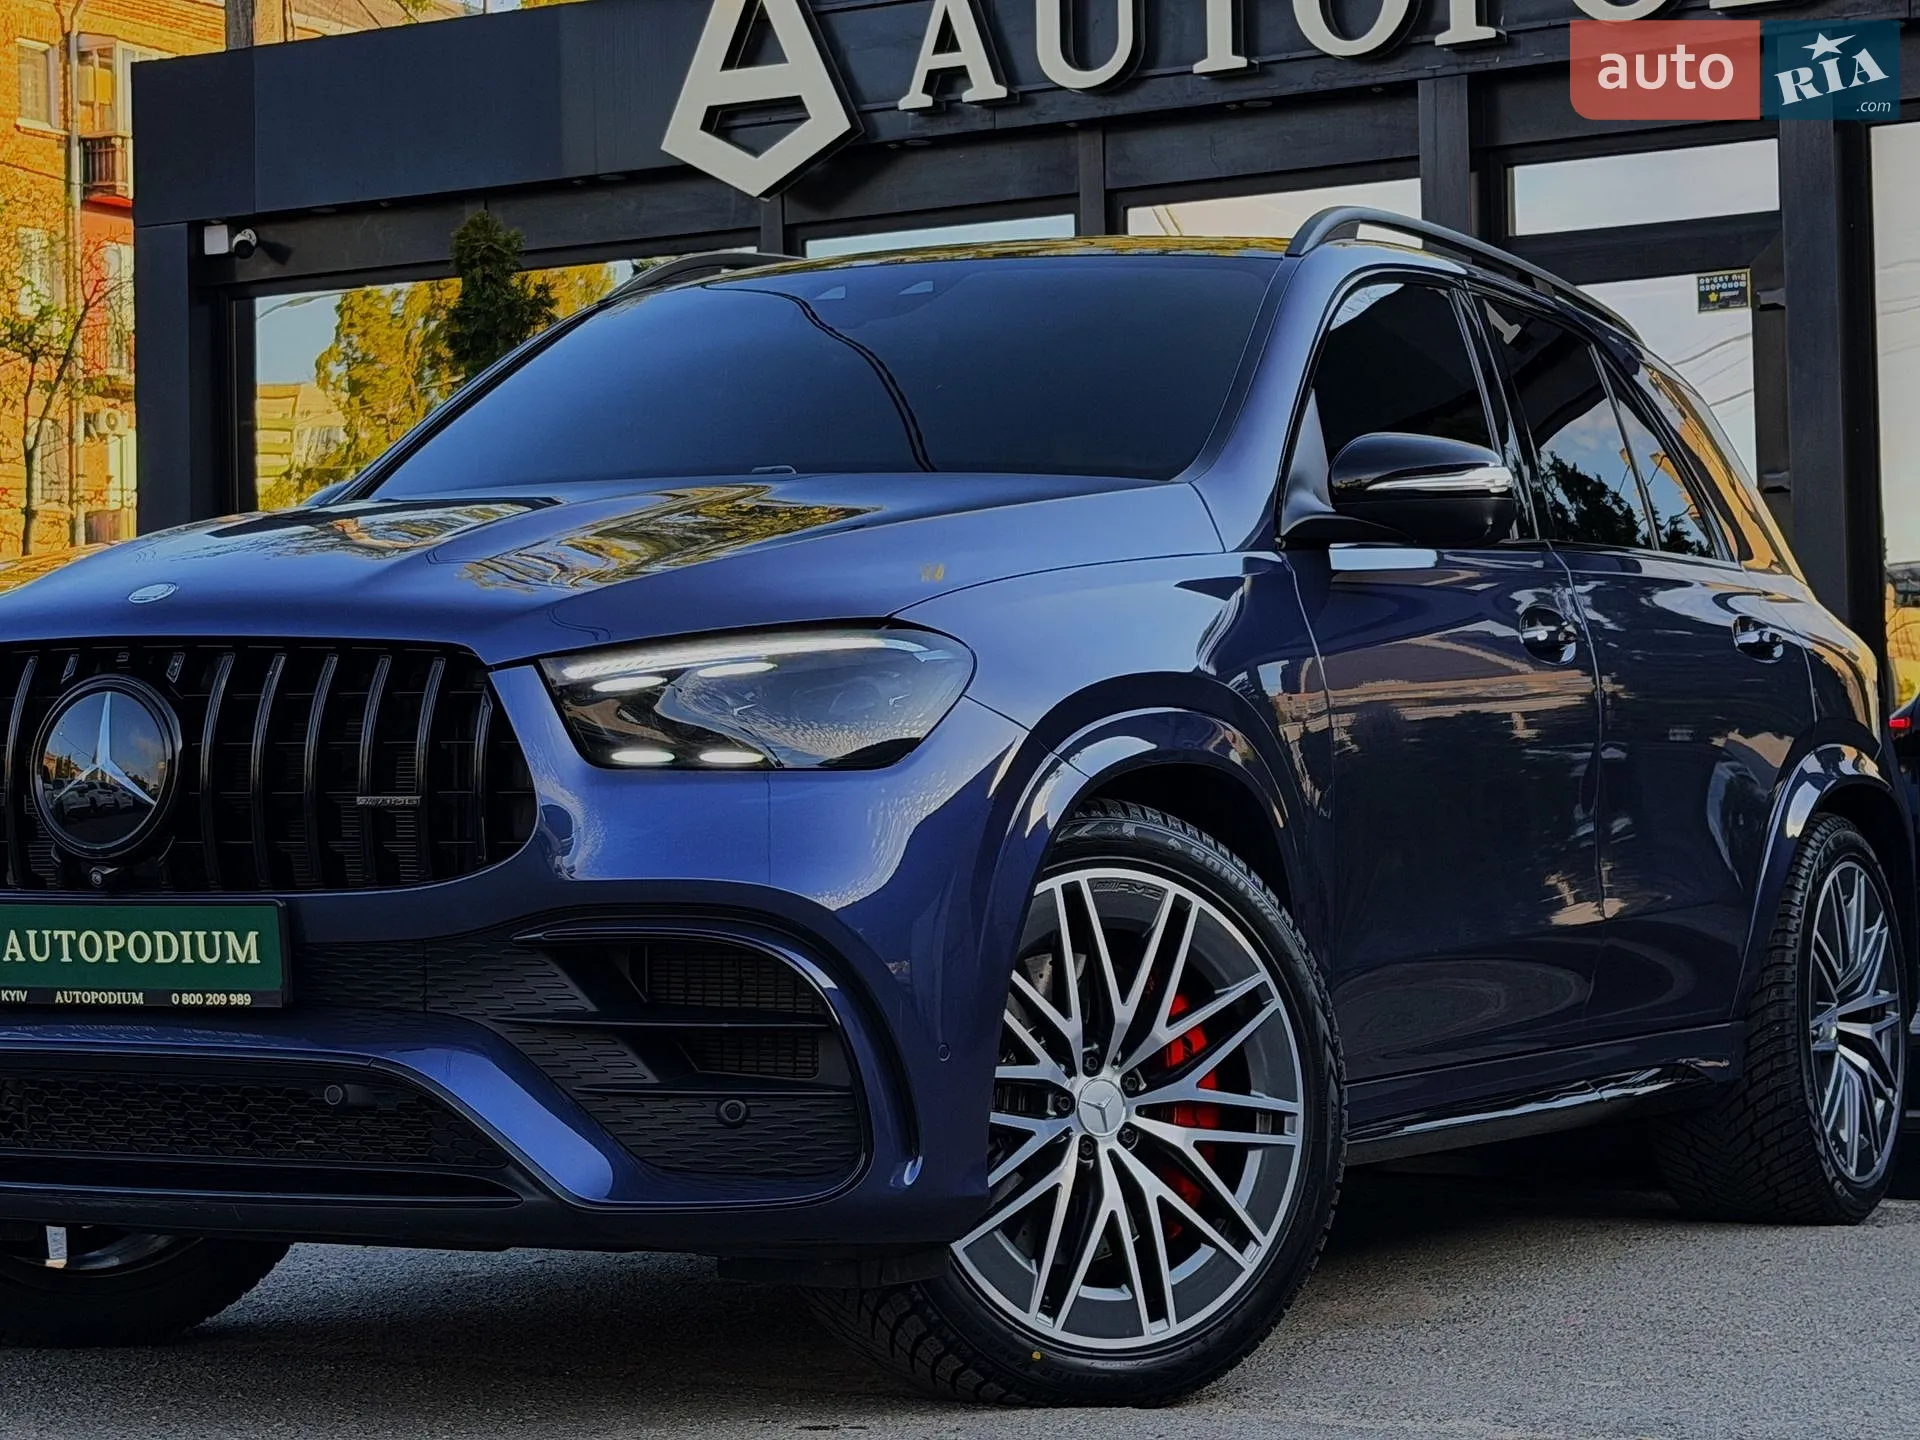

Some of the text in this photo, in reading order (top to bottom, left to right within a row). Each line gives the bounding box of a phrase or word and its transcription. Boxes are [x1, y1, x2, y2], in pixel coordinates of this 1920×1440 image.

[3, 929, 261, 964] AUTOPODIUM
[1, 990, 251, 1006] KYIV AUTOPODIUM 0 800 209 989
